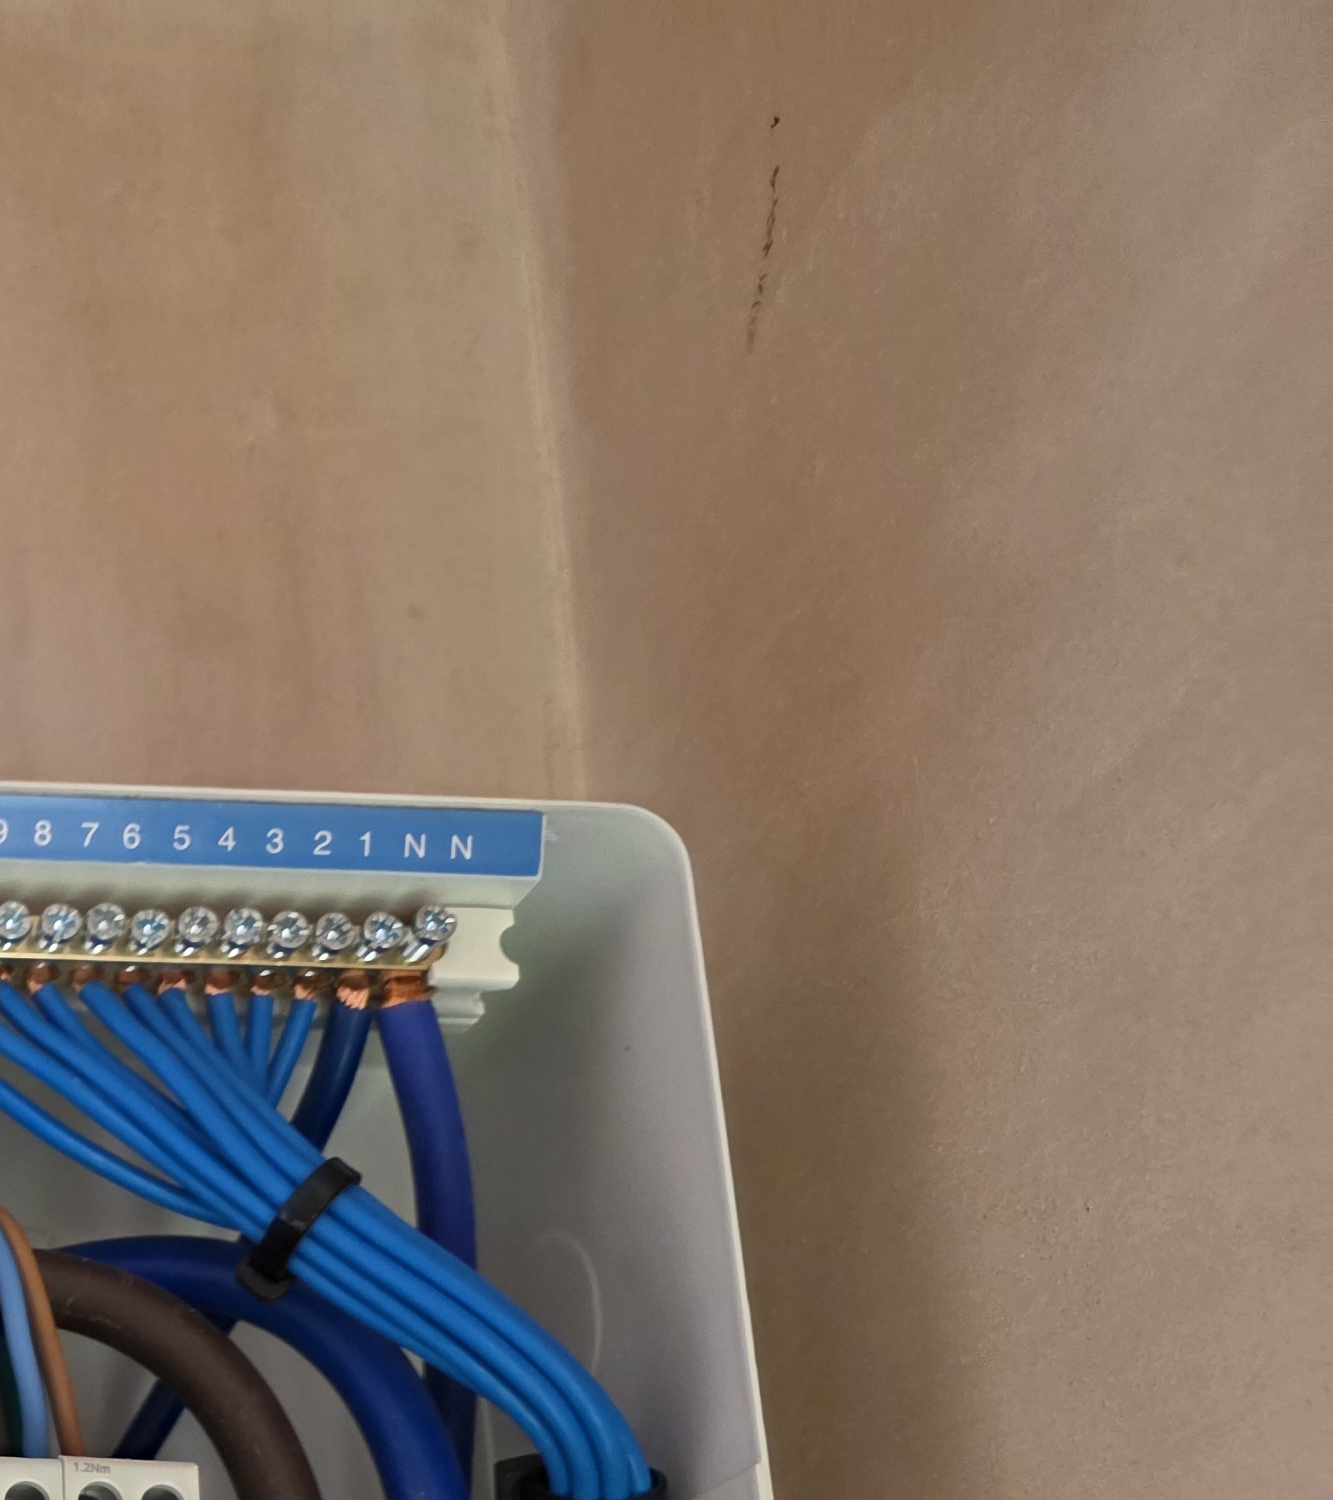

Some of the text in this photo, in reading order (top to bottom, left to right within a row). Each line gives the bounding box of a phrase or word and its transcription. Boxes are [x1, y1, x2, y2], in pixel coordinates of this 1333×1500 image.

[34, 820, 53, 846] 8
[80, 822, 99, 848] 7
[122, 822, 141, 849] 6
[173, 825, 191, 850] 5
[218, 827, 237, 852] 4
[266, 829, 284, 854] 3
[313, 830, 333, 855] 2
[360, 832, 371, 857] 1
[404, 834, 426, 859] N
[450, 835, 473, 860] N
